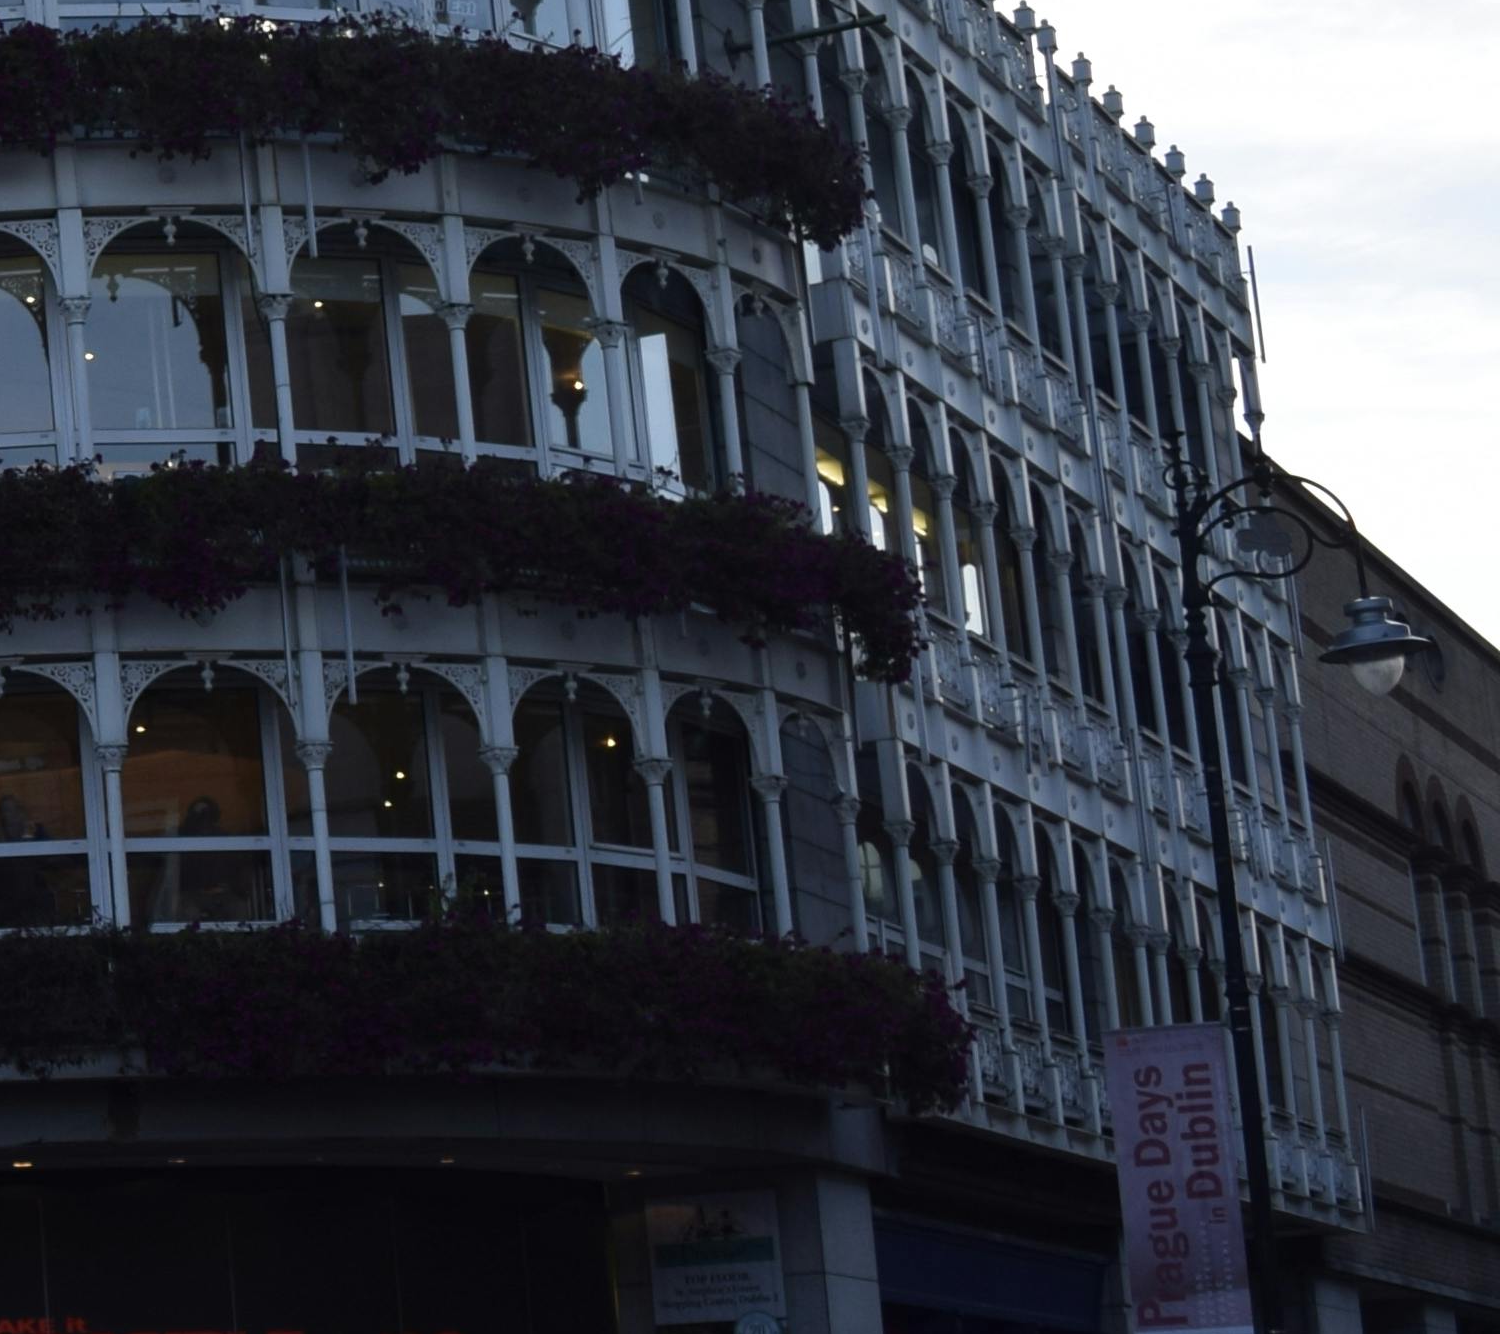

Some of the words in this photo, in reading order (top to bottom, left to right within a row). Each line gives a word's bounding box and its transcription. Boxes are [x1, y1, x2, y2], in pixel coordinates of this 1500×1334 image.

[1133, 1065, 1174, 1168] Days
[1175, 1063, 1224, 1200] Dublin
[1137, 1180, 1190, 1327] Prague
[1209, 1206, 1229, 1224] in
[65, 1315, 87, 1334] it
